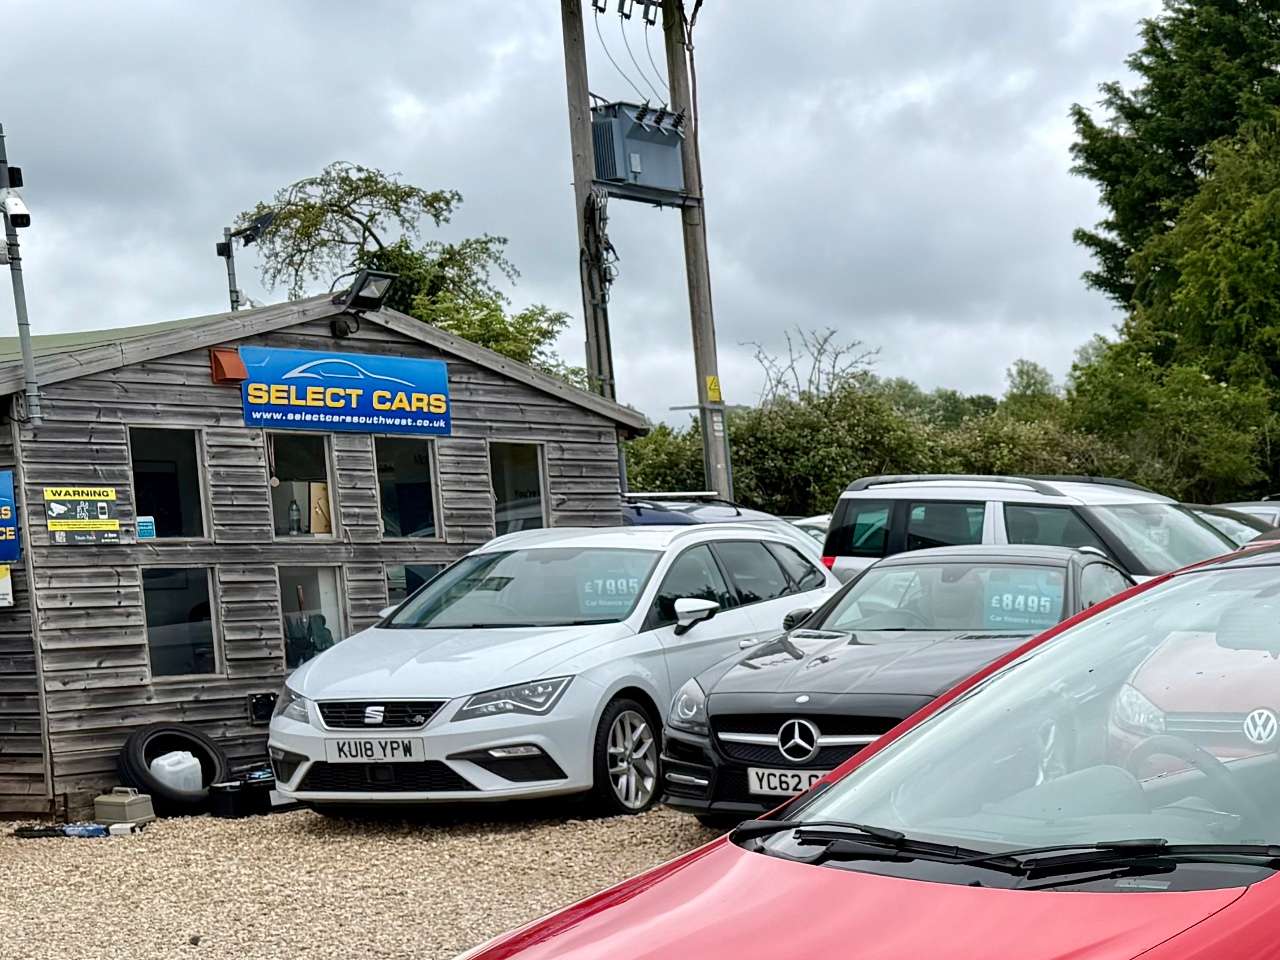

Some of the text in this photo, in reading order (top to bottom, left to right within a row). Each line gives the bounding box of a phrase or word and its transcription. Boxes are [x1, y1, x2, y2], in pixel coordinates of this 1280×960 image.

[247, 382, 447, 414] SELECT CARS
[251, 410, 446, 428] www.selectcarssouthwest.co.uk
[50, 489, 110, 498] WARNING
[584, 578, 640, 595] £7995
[991, 593, 1051, 613] £8495
[336, 740, 413, 758] KU18 YPW
[755, 771, 802, 791] YC62
